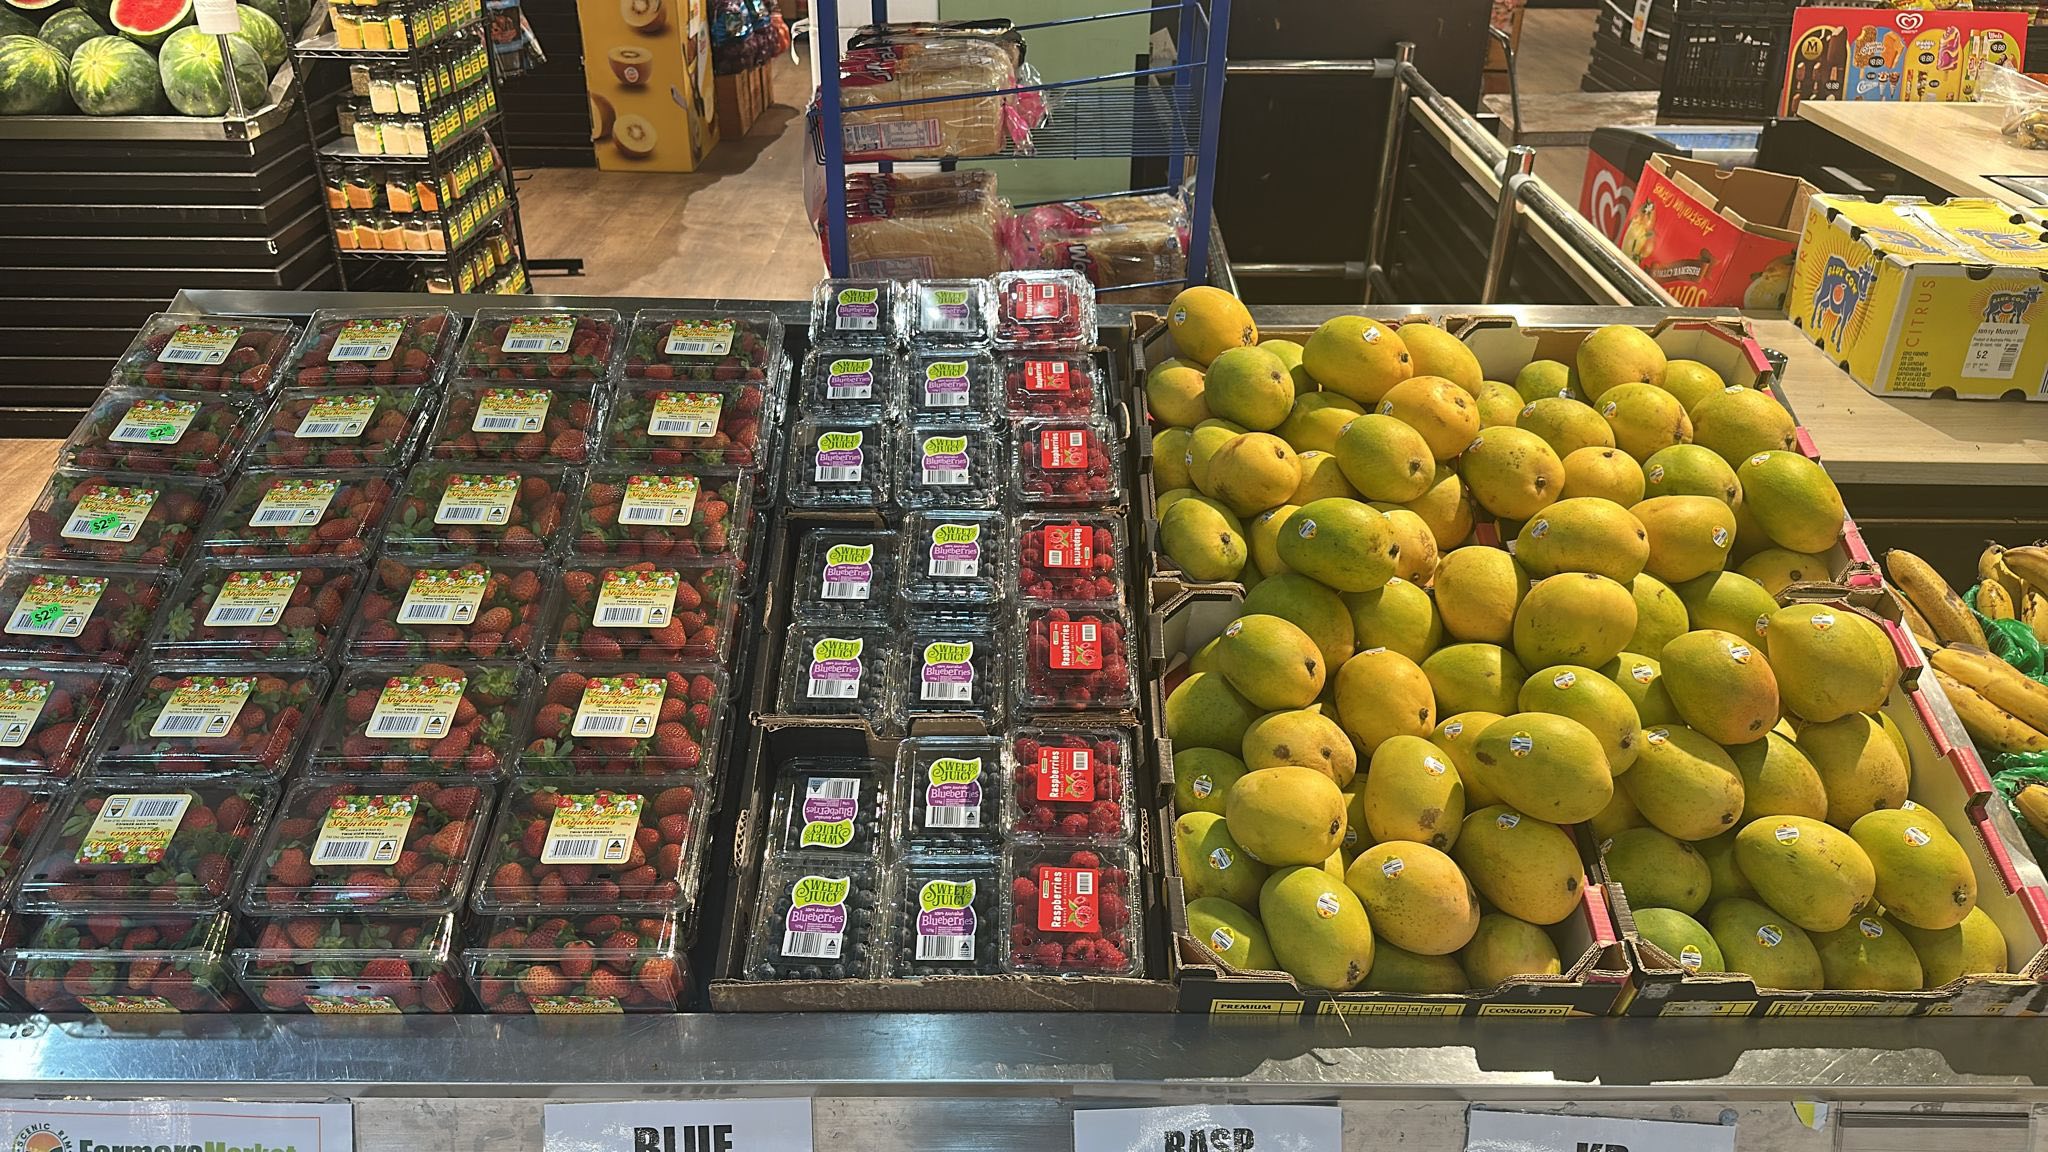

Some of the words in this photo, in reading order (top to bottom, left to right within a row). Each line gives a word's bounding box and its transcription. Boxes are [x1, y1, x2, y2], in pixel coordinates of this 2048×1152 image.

[1828, 266, 1844, 277] BLUE
[1905, 279, 1936, 348] CITRUS
[1060, 624, 1070, 667] Raspberries
[933, 762, 975, 779] SWEET
[941, 772, 972, 782] JUICY
[1049, 751, 1060, 798] Raspberries
[931, 788, 979, 801] Blueberries
[330, 818, 388, 828] Strawberries
[557, 818, 616, 826] Strawberries
[797, 880, 841, 899] SWEET
[924, 884, 968, 901] SWEET
[804, 890, 838, 903] JUICY
[932, 894, 963, 907] JUICY
[1051, 871, 1063, 928] Raspberries
[791, 911, 844, 924] Blueberries
[921, 915, 973, 927] Blueberries
[17, 1122, 51, 1147] SCENIC
[57, 1129, 73, 1149] RIM
